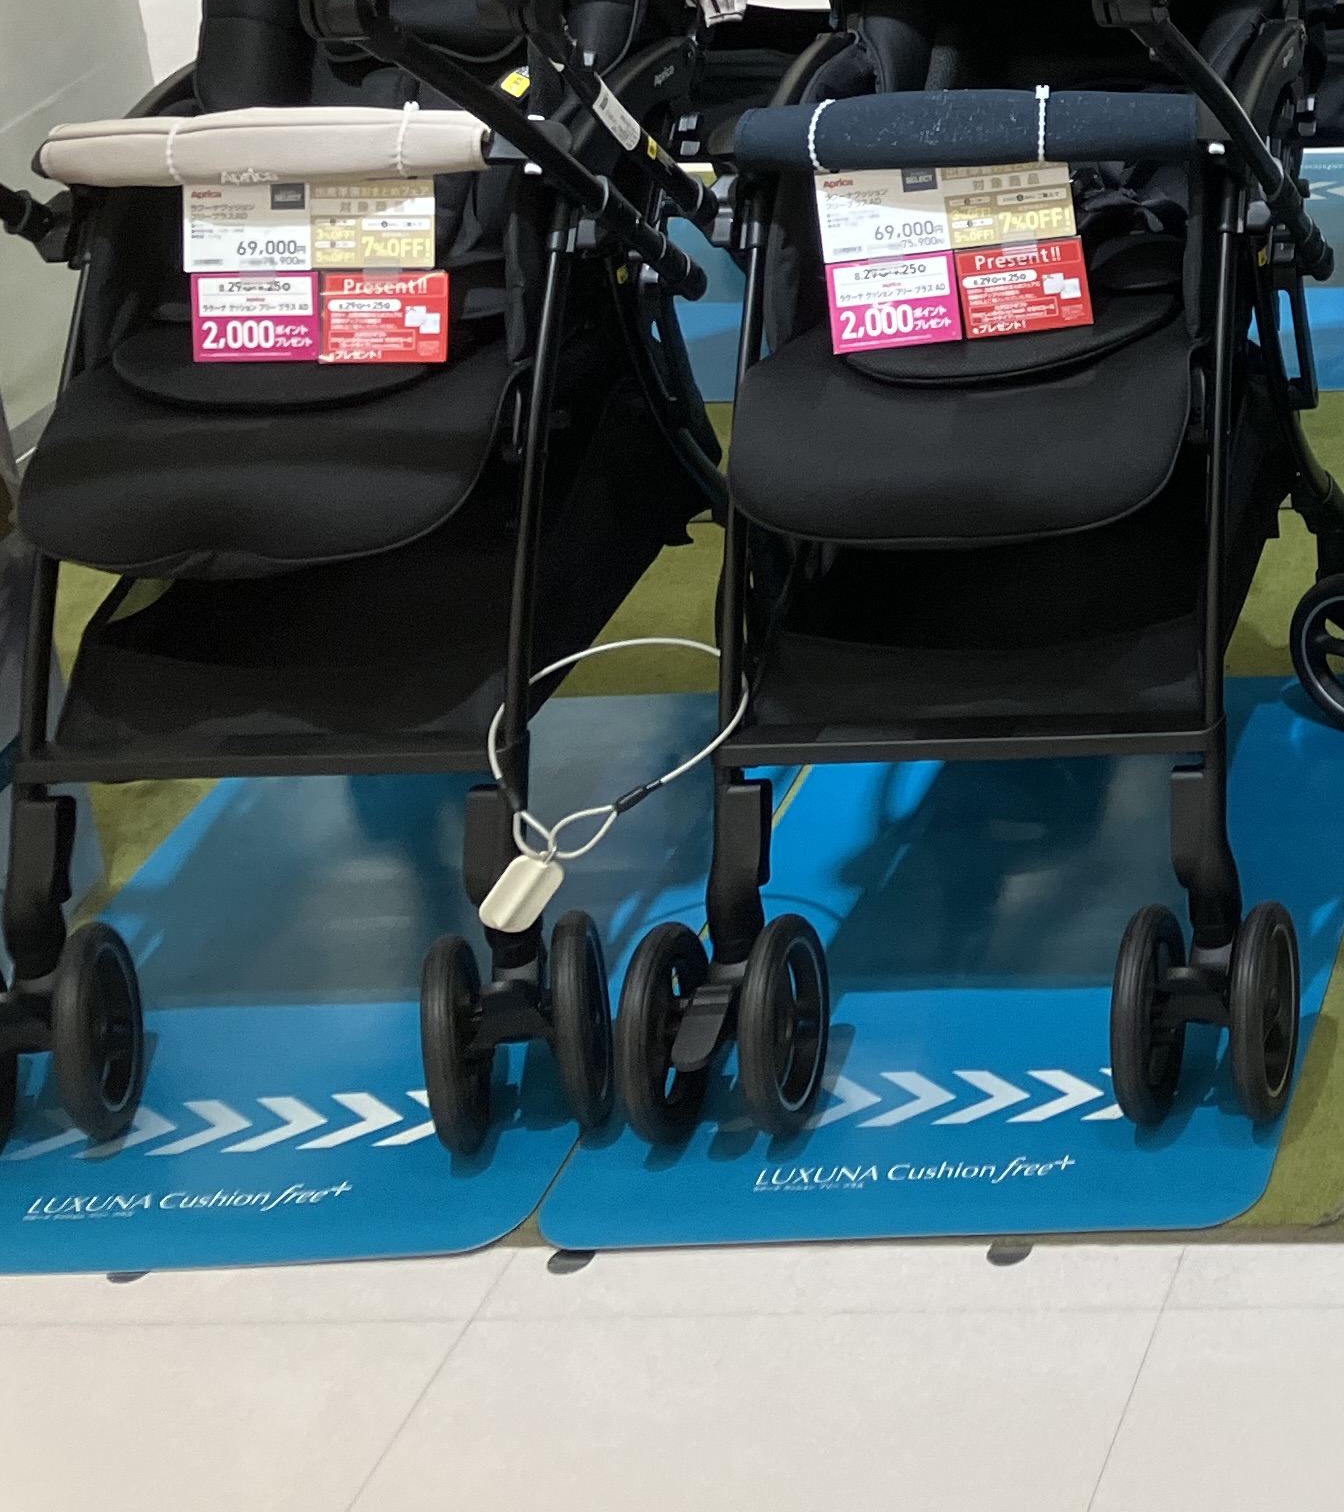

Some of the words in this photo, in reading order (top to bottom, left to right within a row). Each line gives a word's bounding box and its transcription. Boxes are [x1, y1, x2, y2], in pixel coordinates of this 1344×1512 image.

[202, 320, 275, 349] 2,000
[839, 304, 914, 340] 2,000
[754, 1165, 878, 1186] LUXUNA
[887, 1162, 996, 1181] Cushion
[27, 1193, 152, 1215] LUXUNA
[159, 1189, 271, 1210] Cushion
